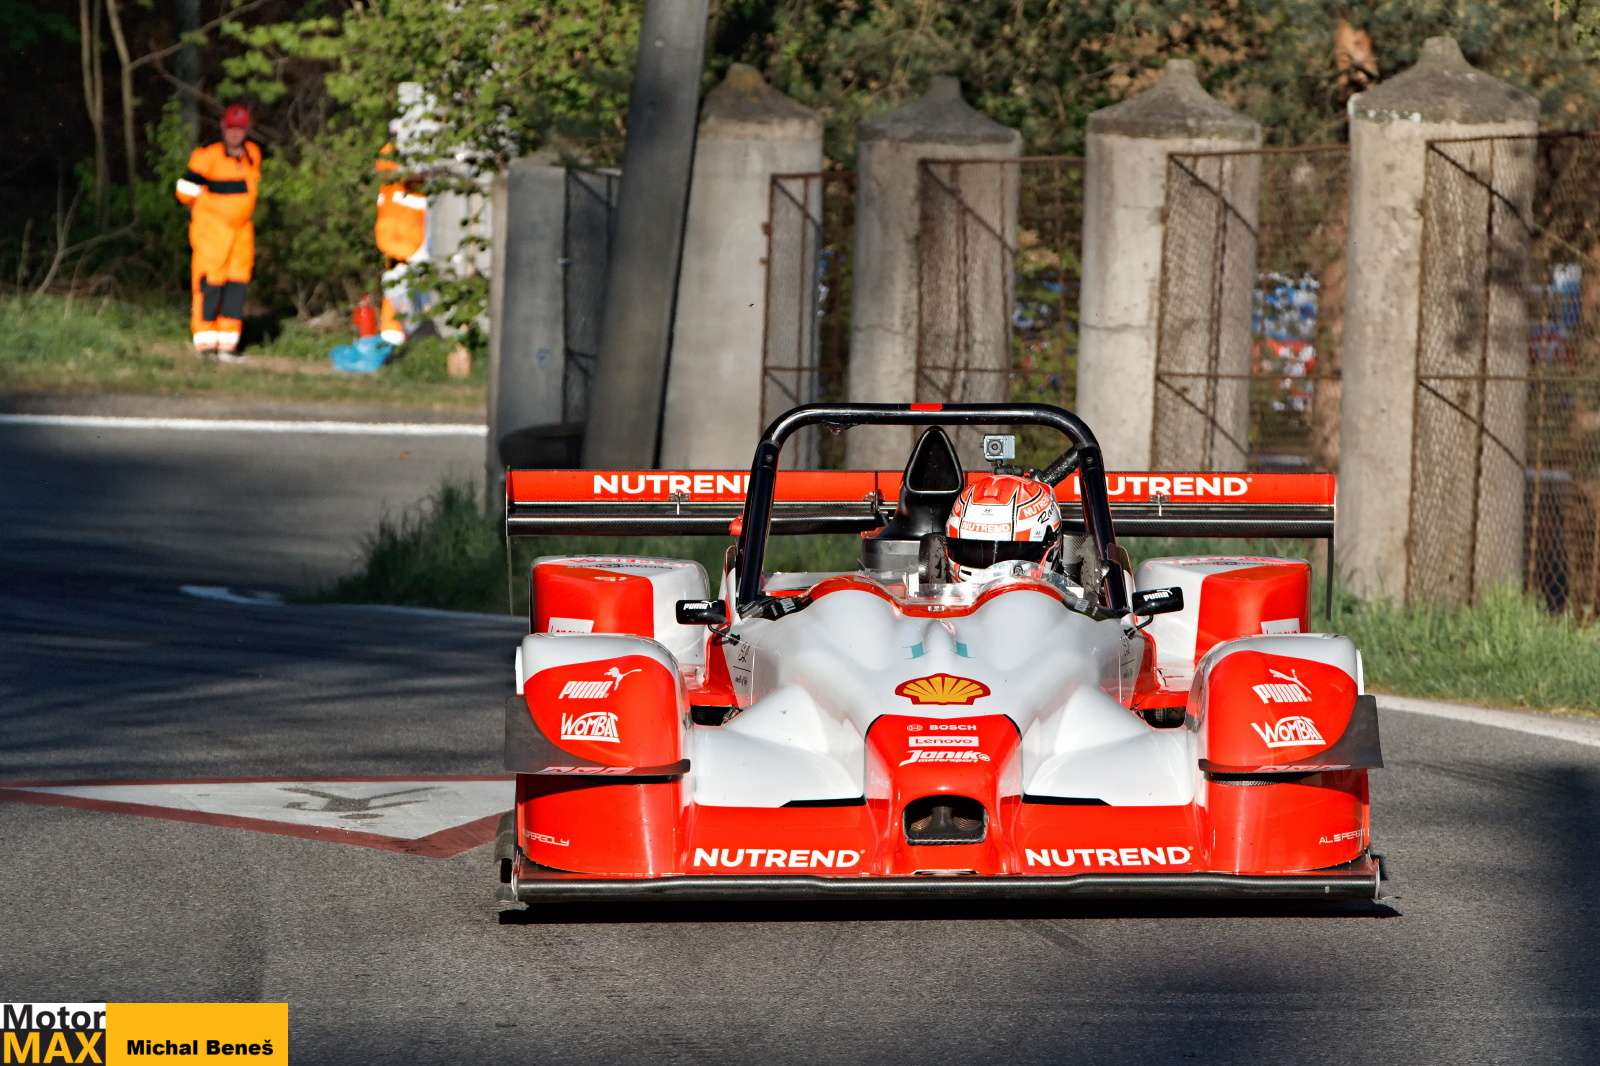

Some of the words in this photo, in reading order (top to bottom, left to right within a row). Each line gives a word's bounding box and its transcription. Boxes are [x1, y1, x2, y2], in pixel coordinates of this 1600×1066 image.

[593, 474, 751, 494] NUTREN
[1143, 591, 1170, 601] PUMA
[683, 602, 709, 610] PUMA
[558, 681, 614, 699] PUMA
[1251, 683, 1309, 704] PUMA
[560, 711, 620, 743] WOMBAT
[693, 848, 860, 867] NUTREND
[1024, 846, 1191, 867] NUTREND
